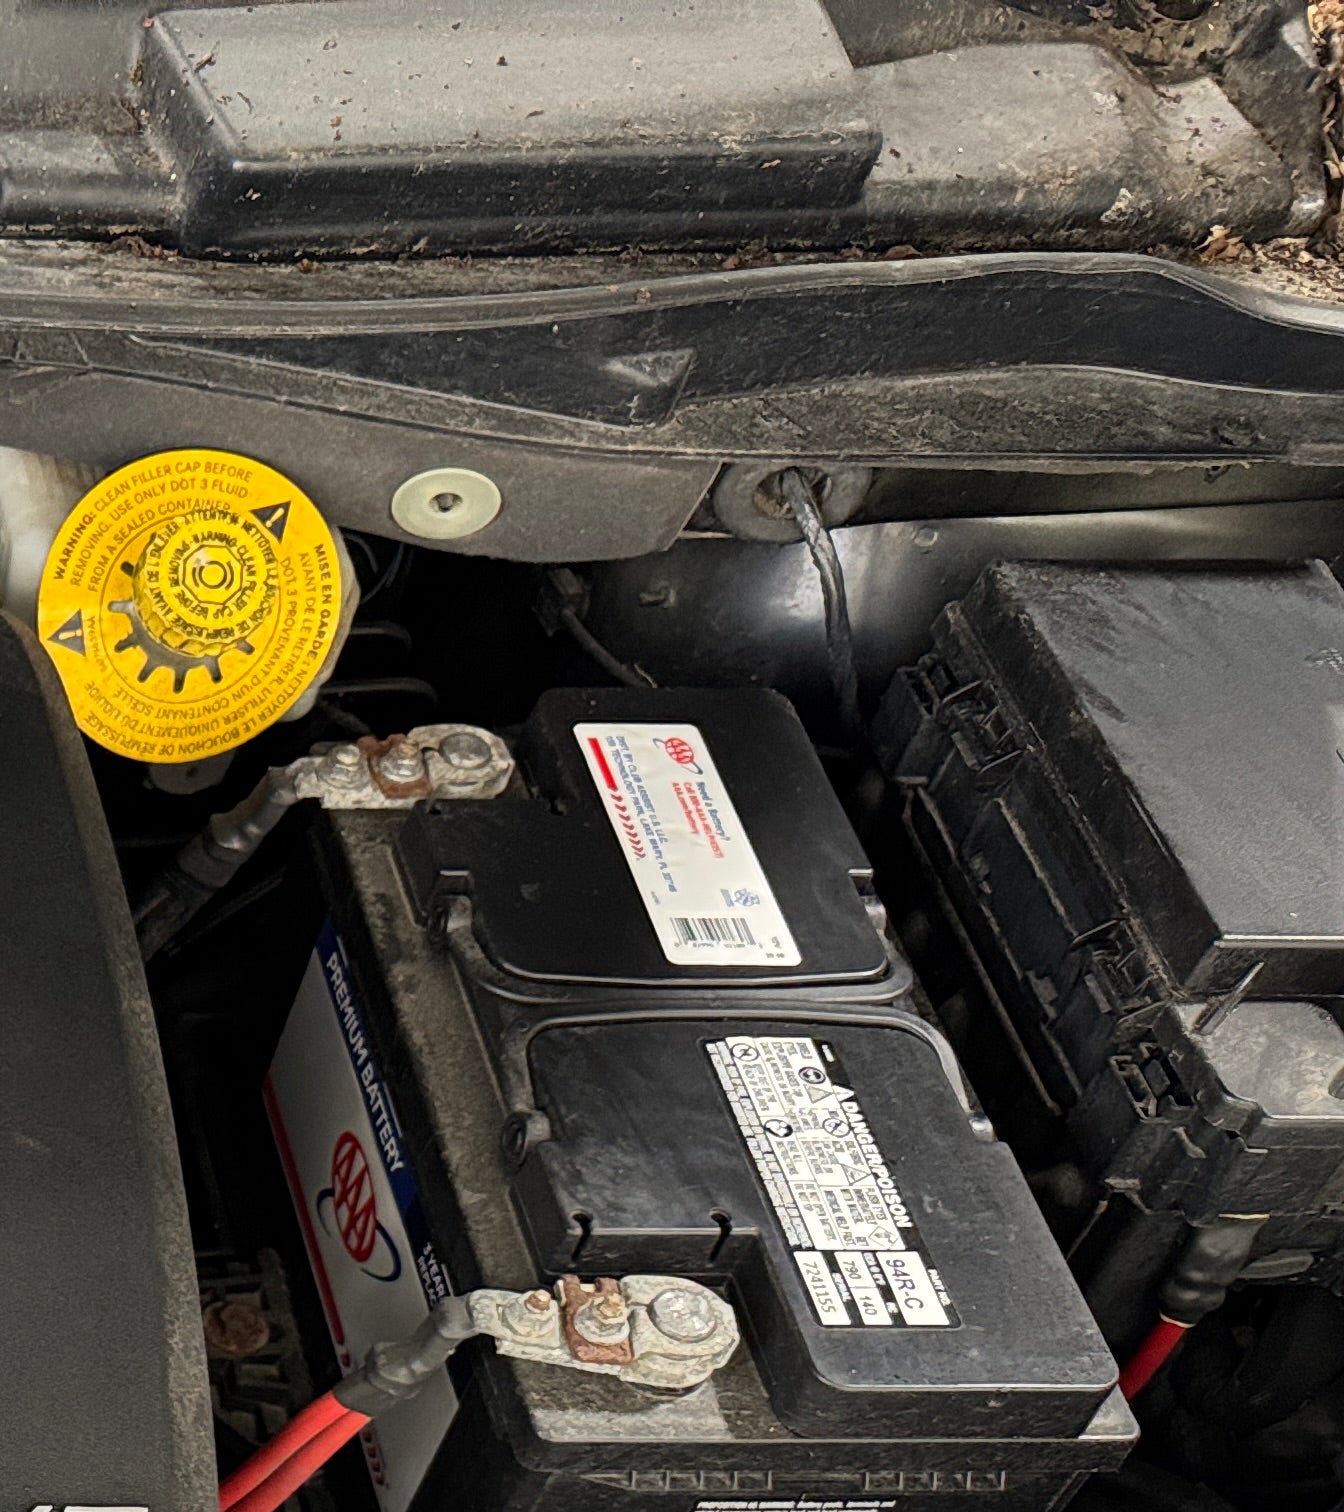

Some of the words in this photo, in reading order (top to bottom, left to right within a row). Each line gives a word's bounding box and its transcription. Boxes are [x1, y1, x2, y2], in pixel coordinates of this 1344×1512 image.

[108, 499, 134, 521] USE
[131, 482, 167, 505] ONLY
[169, 477, 195, 490] DOT
[200, 479, 208, 489] 3
[211, 478, 249, 500] FLUID
[53, 509, 97, 580] WARNING:
[92, 481, 130, 513] CLEAN
[130, 466, 172, 486] FILLER
[175, 462, 200, 473] CAP
[204, 461, 252, 484] BEFORE
[86, 553, 110, 592] FROM
[103, 541, 117, 554] A
[110, 508, 157, 545] SEALED
[309, 542, 335, 580] MISE
[297, 549, 315, 593] AVANT
[285, 587, 298, 596] 3
[303, 597, 315, 614] DE
[320, 584, 333, 604] EN
[257, 600, 296, 679] PROVENANT
[300, 618, 312, 634] LE
[306, 609, 330, 660] GARDE
[230, 674, 262, 702] D'UN
[255, 667, 308, 722] NETTOYER
[154, 695, 230, 719] CONTENANT
[221, 686, 272, 725] UTILISER
[118, 713, 139, 732] DU
[139, 719, 220, 737] UNIQUEMENT
[178, 726, 241, 752] BOUCHON
[240, 717, 258, 733] LE
[158, 743, 174, 756] DE
[326, 952, 370, 1065] PREMIUM
[360, 1061, 405, 1174] BATTERY
[840, 1101, 912, 1227] DANGER/POISON
[801, 1261, 836, 1312] 7241155
[841, 1261, 862, 1279] 790
[884, 1259, 925, 1309] 94R-C
[856, 1295, 878, 1315] 140
